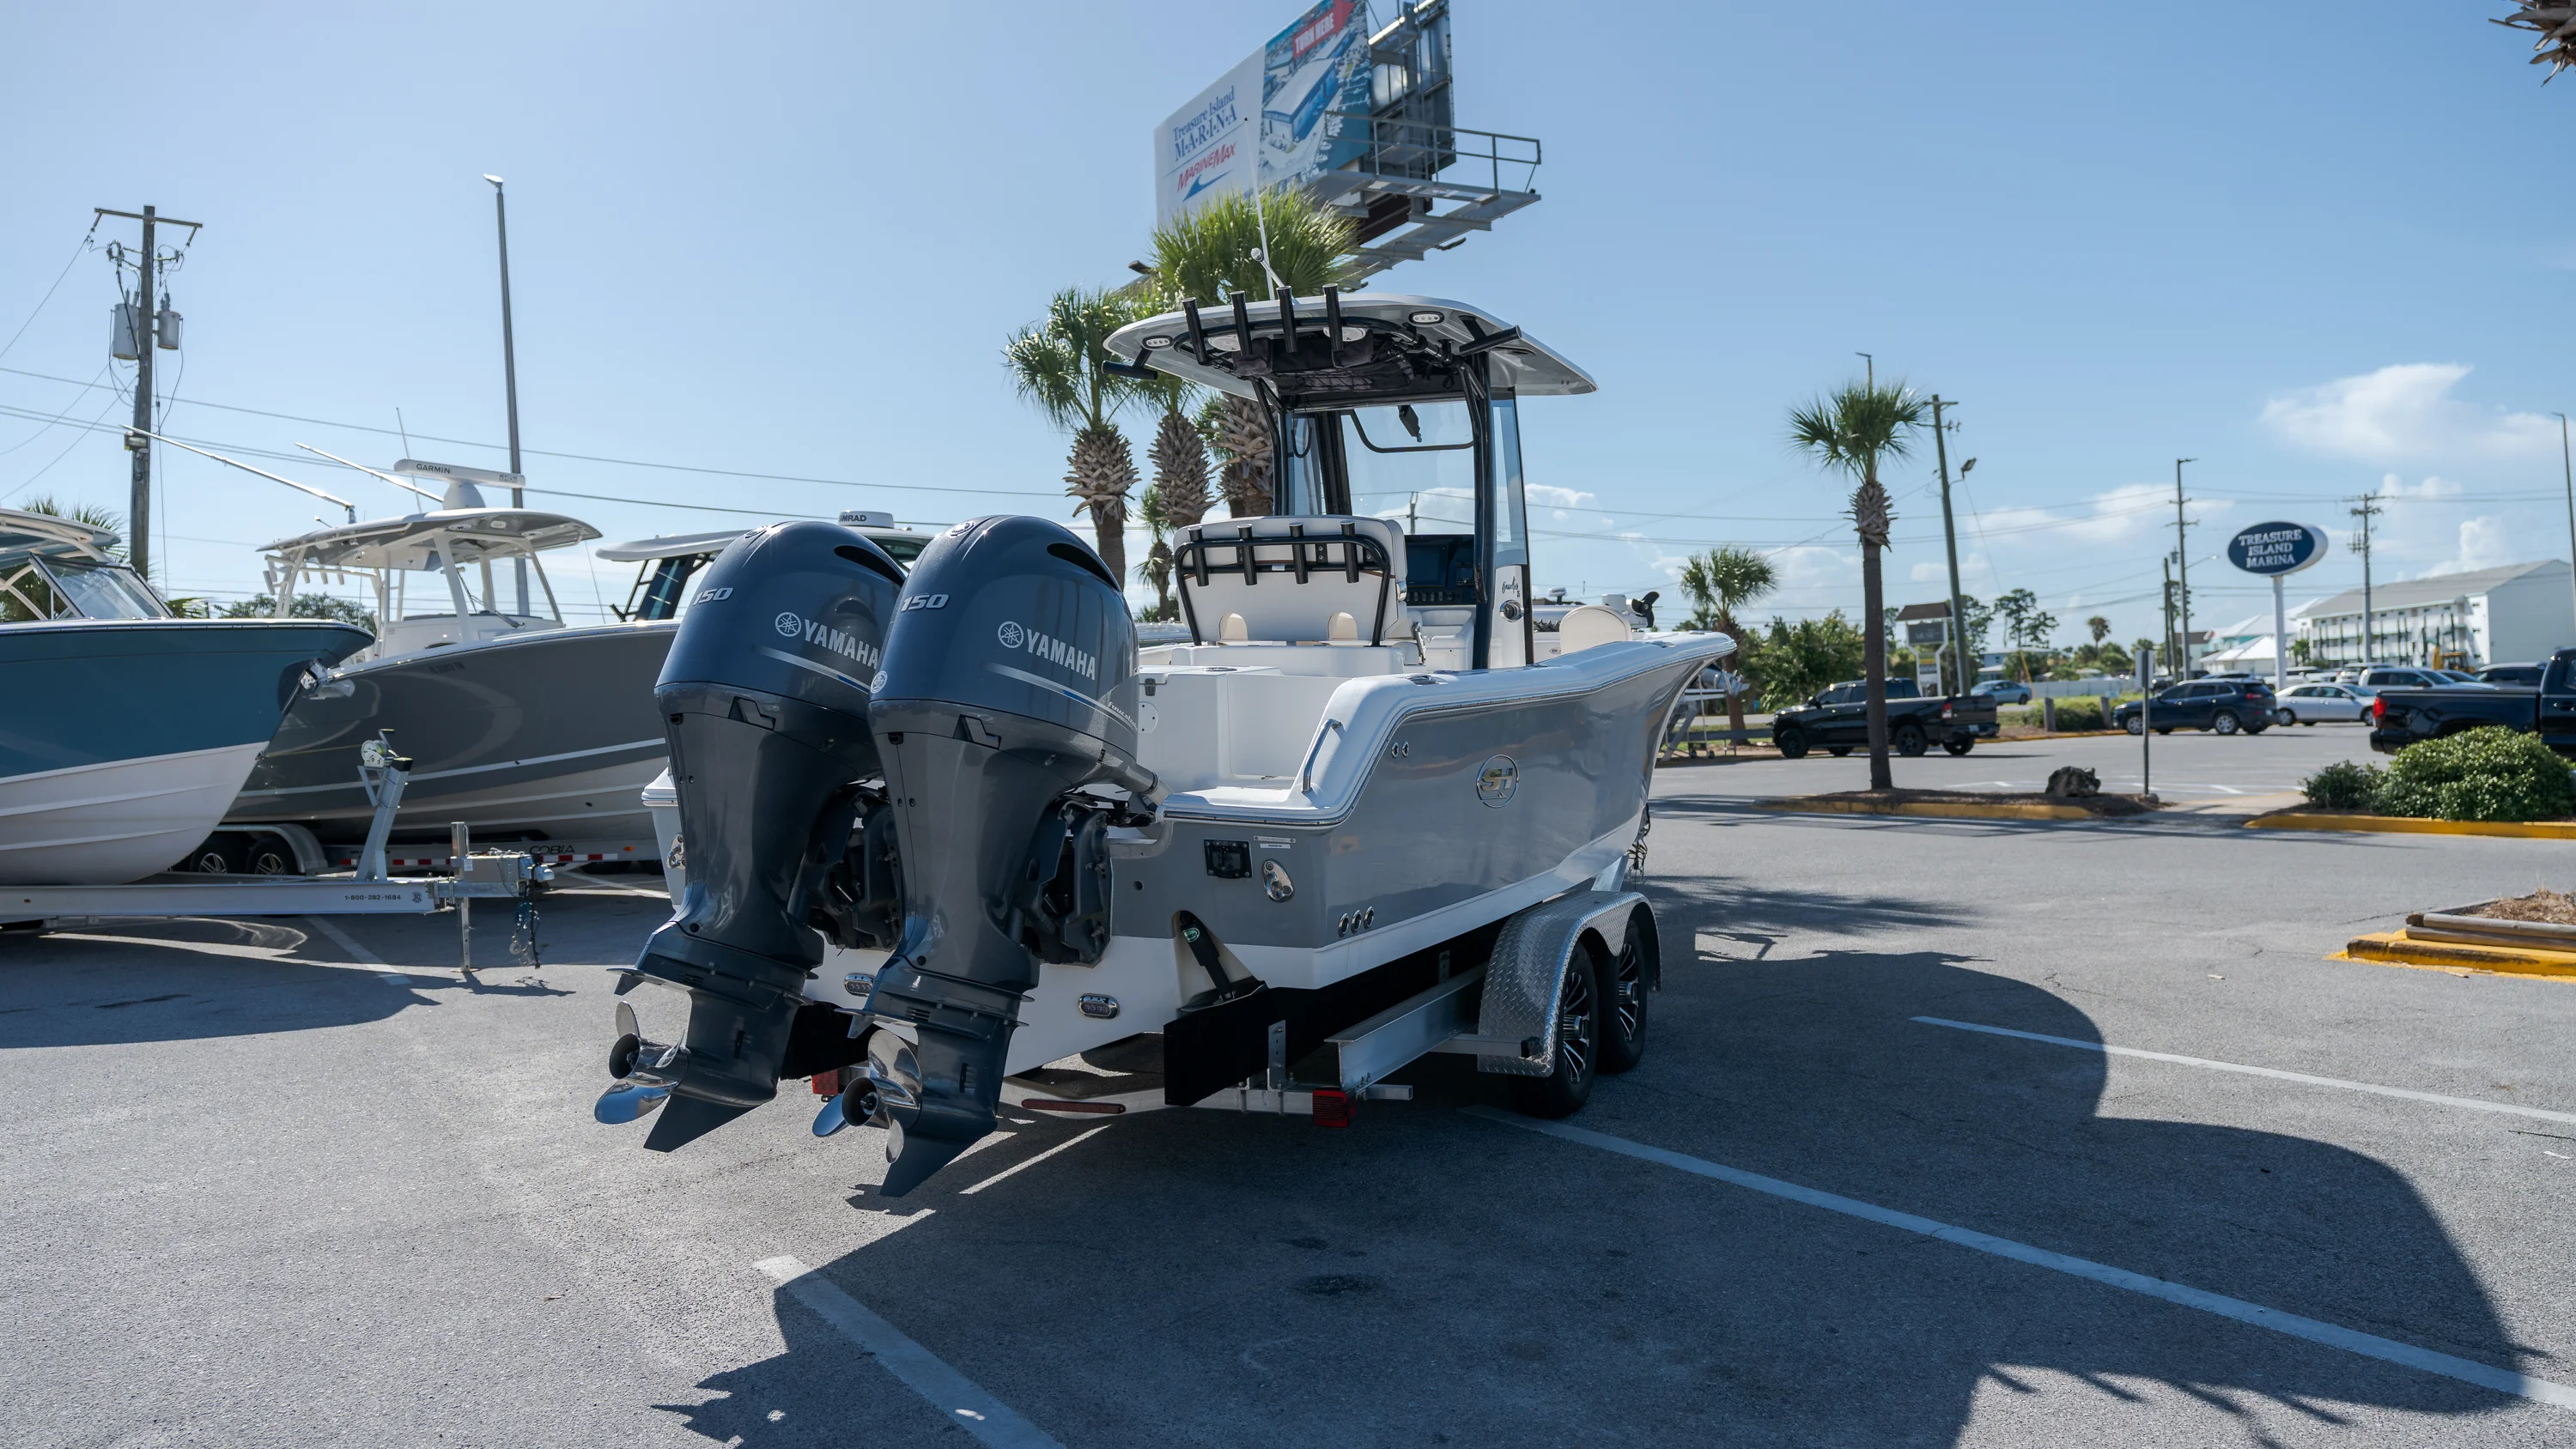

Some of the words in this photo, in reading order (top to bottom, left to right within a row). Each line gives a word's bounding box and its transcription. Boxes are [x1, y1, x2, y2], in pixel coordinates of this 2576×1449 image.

[1295, 26, 1315, 54] TURN
[1315, 12, 1334, 40] HERE
[1173, 109, 1208, 141] Treasure
[1209, 85, 1235, 117] Island
[416, 464, 451, 474] GARMIN
[2239, 529, 2302, 546] TREASURE
[2248, 543, 2293, 556] ISLAND
[2245, 553, 2295, 568] MARINA
[692, 587, 734, 606] 150
[901, 593, 951, 612] 150
[804, 619, 879, 670] YAMAHA
[1026, 628, 1096, 681] YAMAHA
[1480, 767, 1513, 791] SH
[529, 845, 575, 855] COBIA
